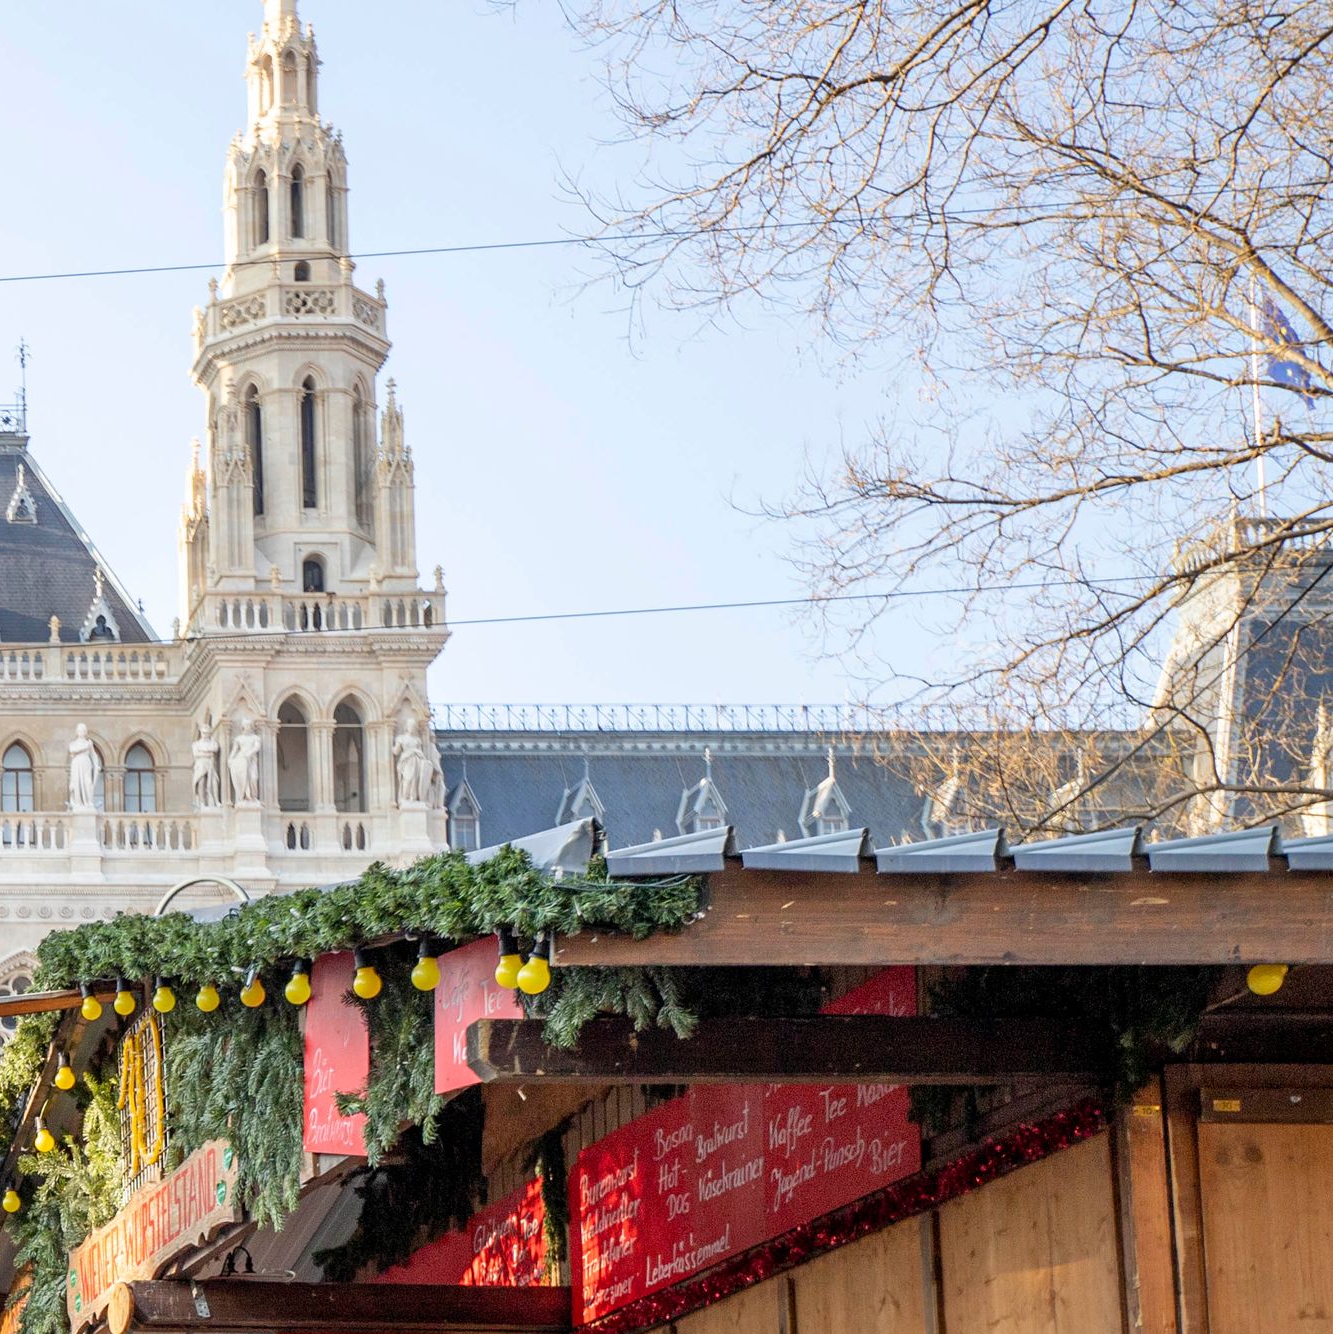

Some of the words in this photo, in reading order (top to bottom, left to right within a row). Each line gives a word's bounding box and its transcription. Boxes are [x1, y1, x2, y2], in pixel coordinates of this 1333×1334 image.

[695, 1100, 750, 1164] Bratwurst
[768, 1104, 813, 1159] Kaffee
[819, 1086, 847, 1123] Tee
[868, 1131, 908, 1175] Bier
